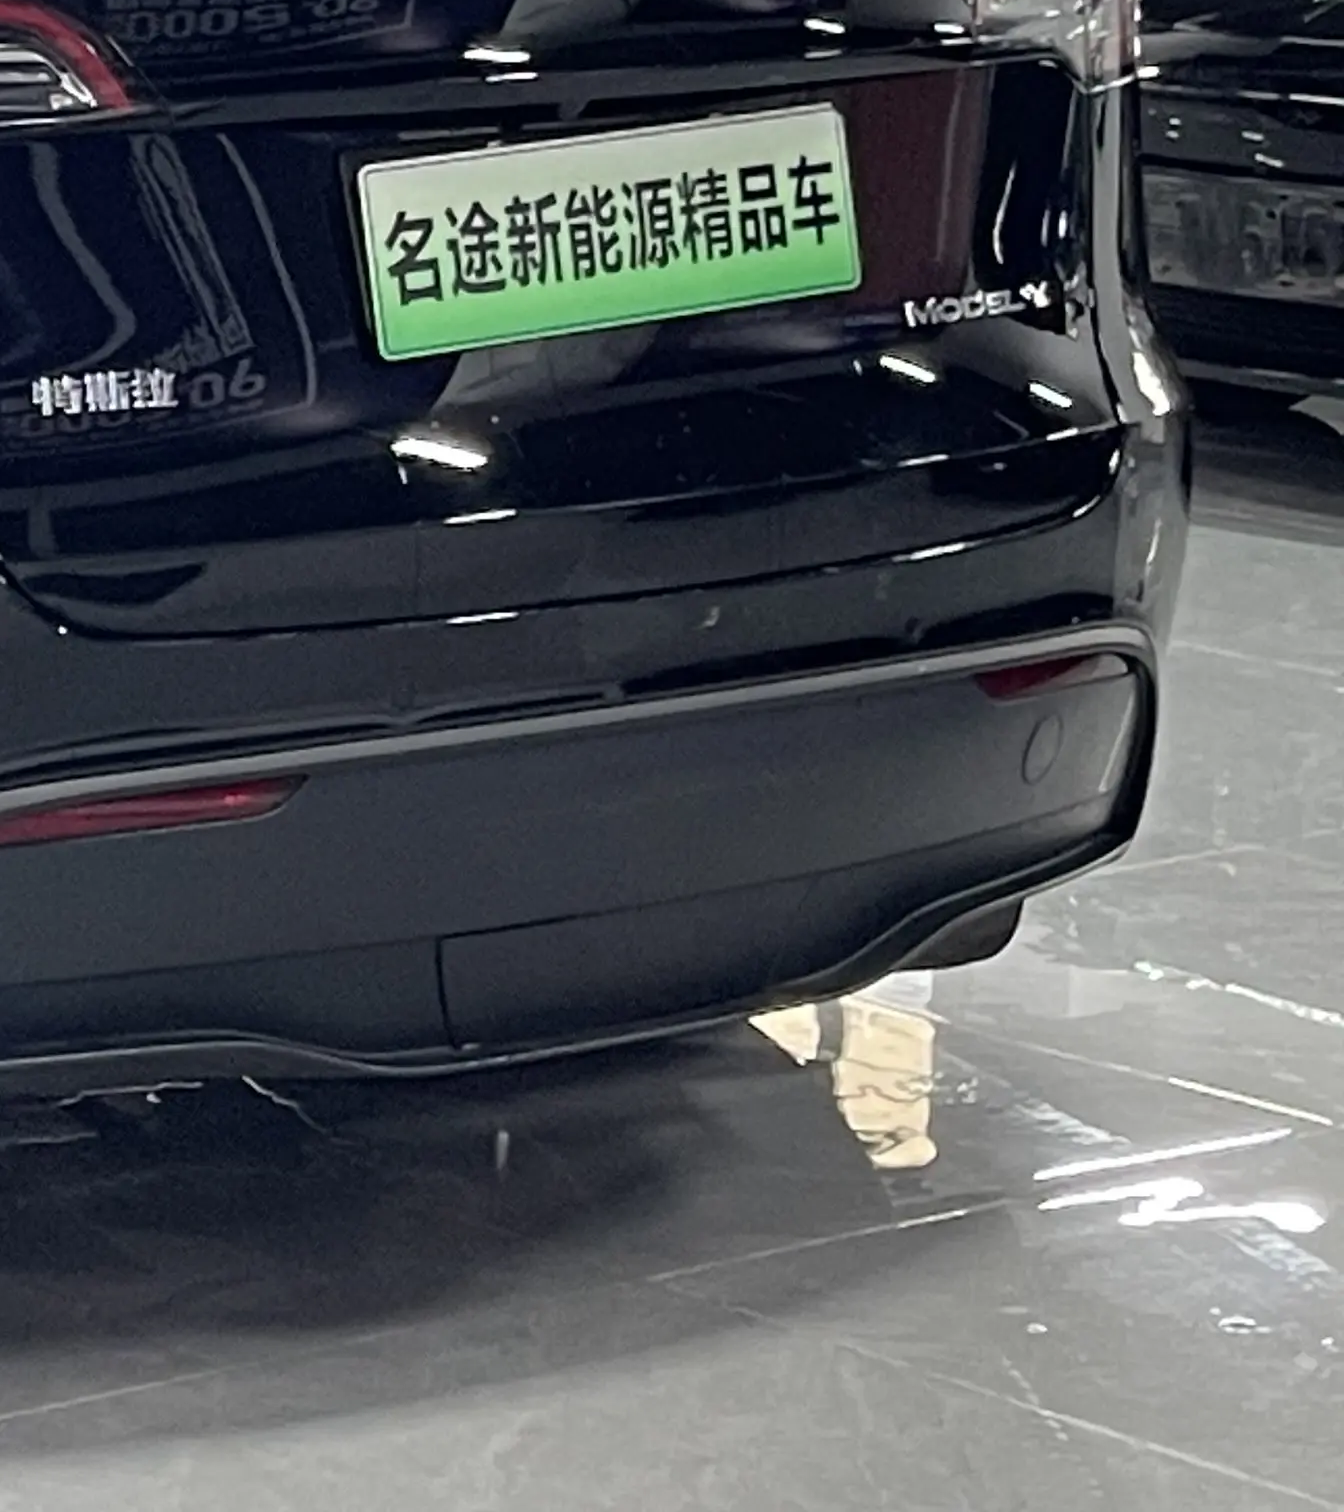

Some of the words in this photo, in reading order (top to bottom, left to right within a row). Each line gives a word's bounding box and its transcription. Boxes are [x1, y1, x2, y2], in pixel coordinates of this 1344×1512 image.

[384, 155, 841, 307] 名途新能源精品车
[32, 367, 179, 416] 特斯拉
